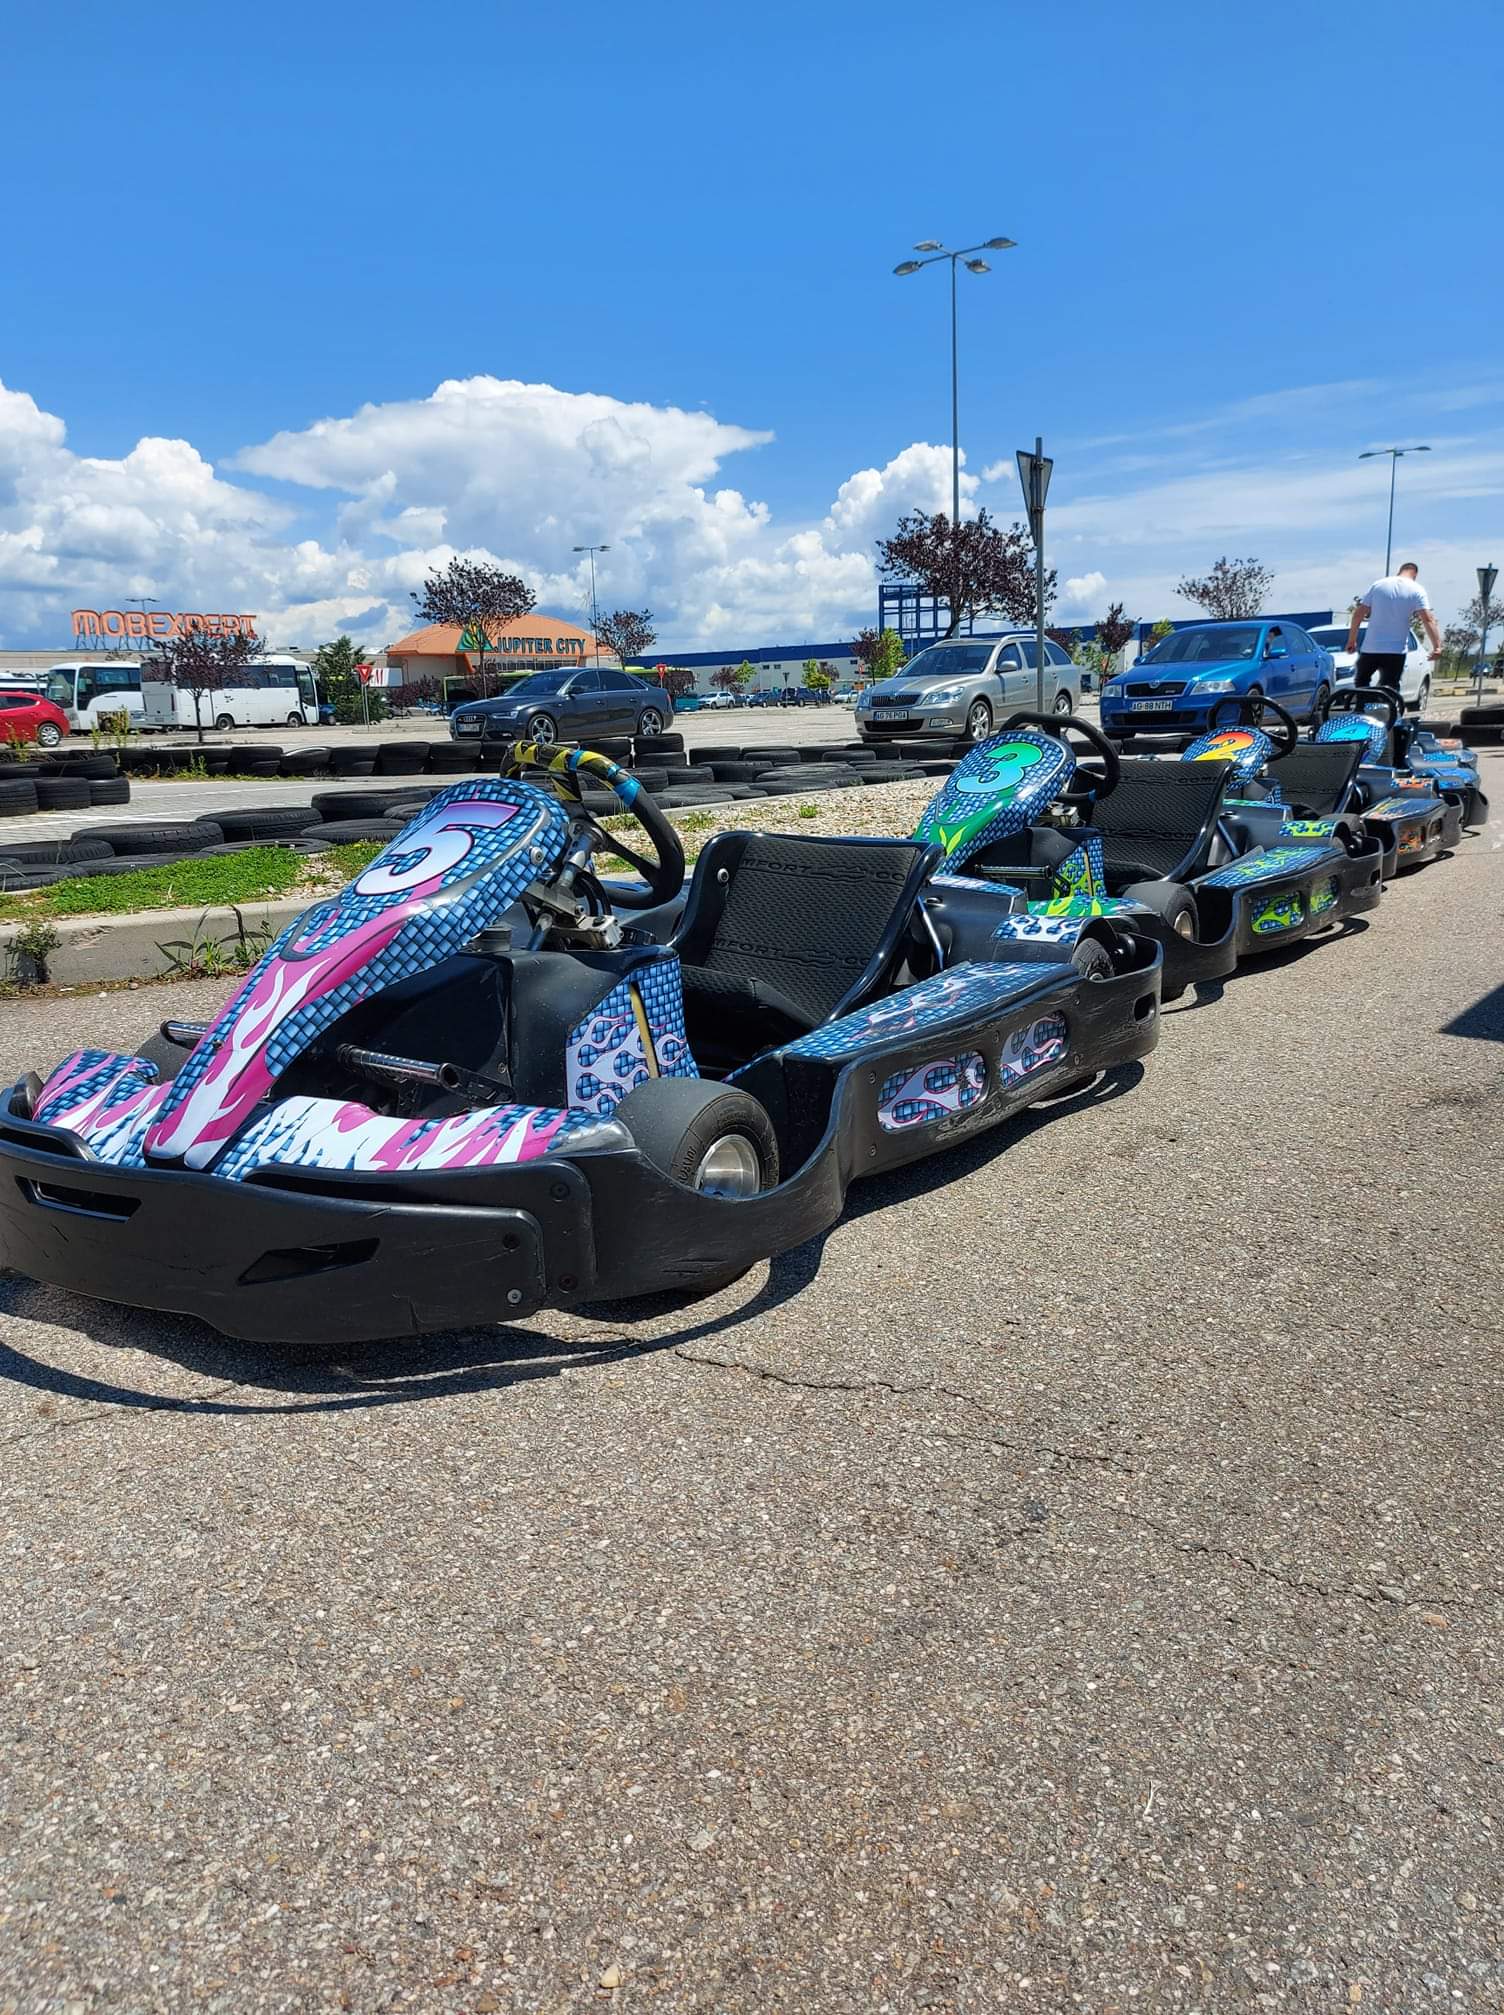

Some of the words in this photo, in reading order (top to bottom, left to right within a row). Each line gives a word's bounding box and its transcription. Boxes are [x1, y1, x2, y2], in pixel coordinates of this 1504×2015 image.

[71, 609, 257, 639] MOBEXPERT
[495, 637, 553, 654] JUPITER
[556, 638, 586, 655] CITY
[1193, 731, 1254, 762] 2
[955, 742, 1043, 793] 3
[355, 801, 521, 896] 5
